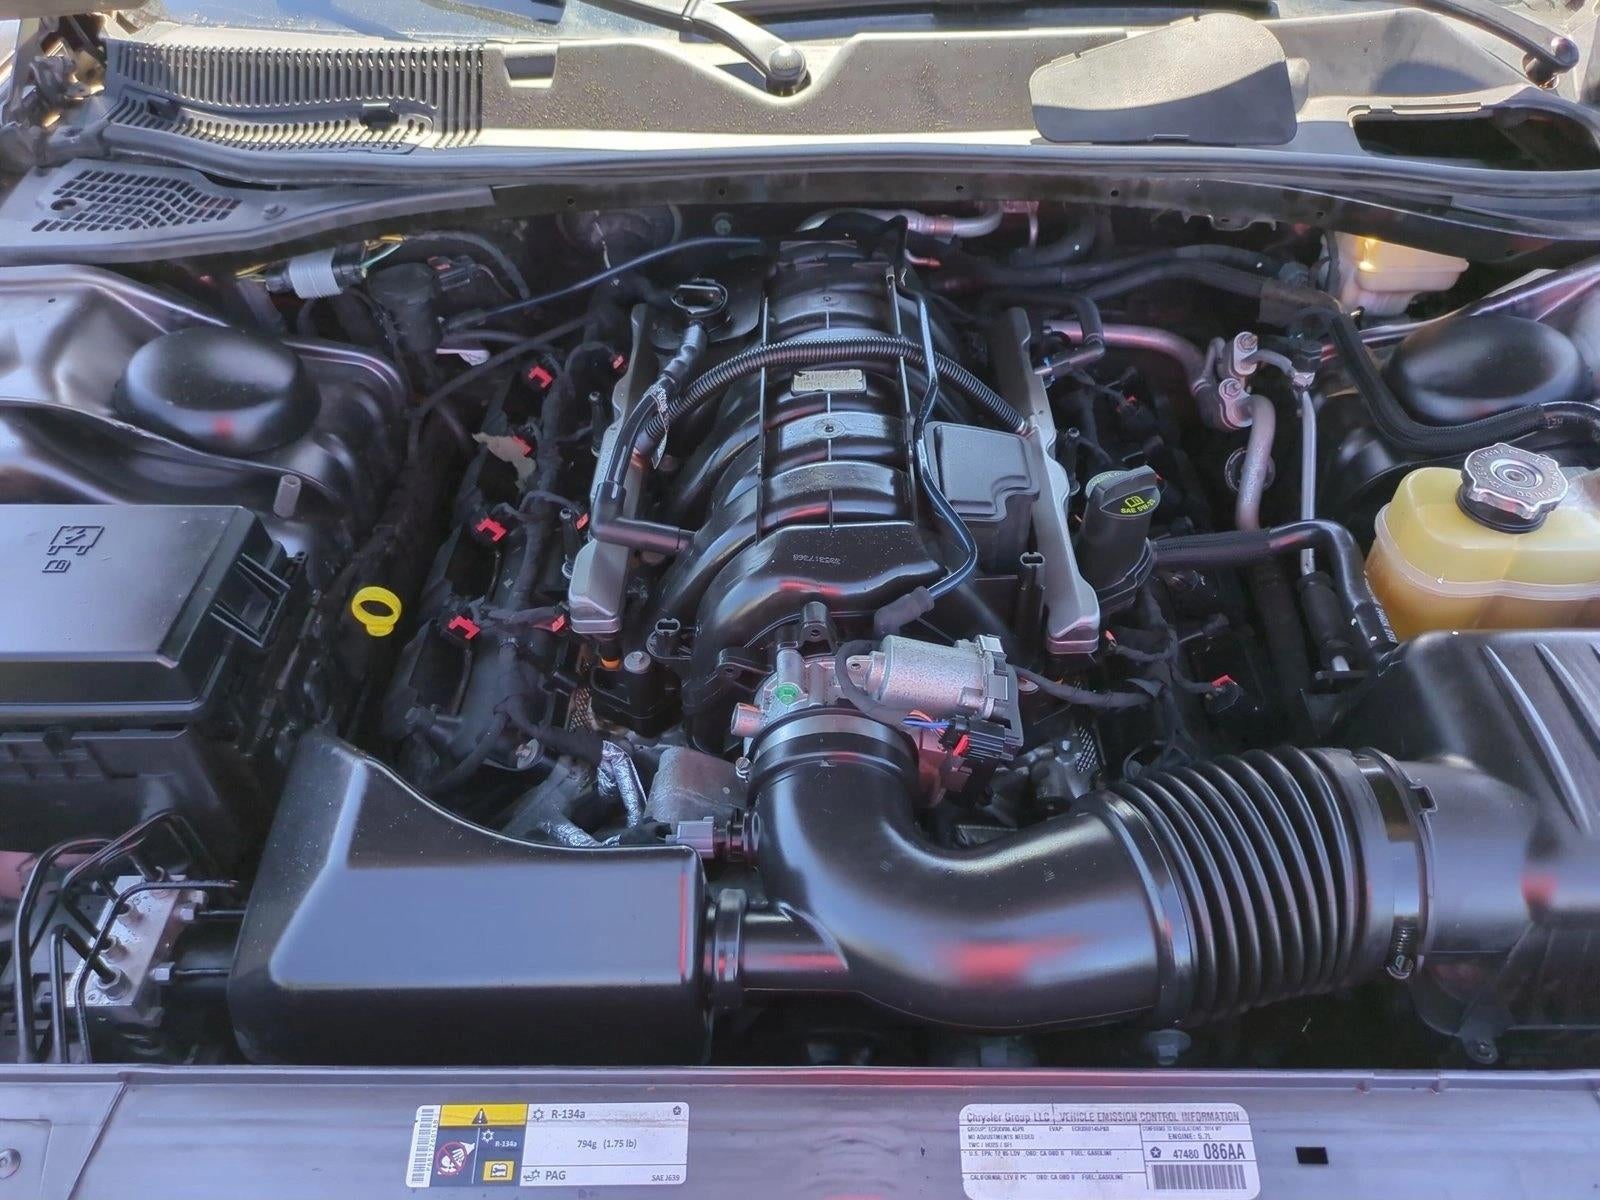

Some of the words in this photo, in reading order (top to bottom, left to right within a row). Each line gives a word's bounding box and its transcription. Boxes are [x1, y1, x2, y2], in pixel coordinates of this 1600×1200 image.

[551, 1109, 586, 1119] R-134a
[966, 1112, 1002, 1123] Chrysler
[1005, 1112, 1031, 1123] Group
[1034, 1112, 1050, 1122] LLC
[1059, 1112, 1095, 1122] VEHICLE
[1097, 1112, 1138, 1122] EMISSION
[1140, 1112, 1178, 1122] CONTROL
[1181, 1111, 1240, 1122] INFORMATION
[495, 1140, 518, 1148] R-134a
[577, 1139, 597, 1150] 794g
[603, 1139, 624, 1149] (1.75
[625, 1138, 638, 1149] lb)
[1173, 1150, 1199, 1159] 47480
[1203, 1143, 1246, 1159] 086AA
[545, 1170, 566, 1180] PAG
[651, 1174, 664, 1182] SAE
[664, 1174, 680, 1182] J639
